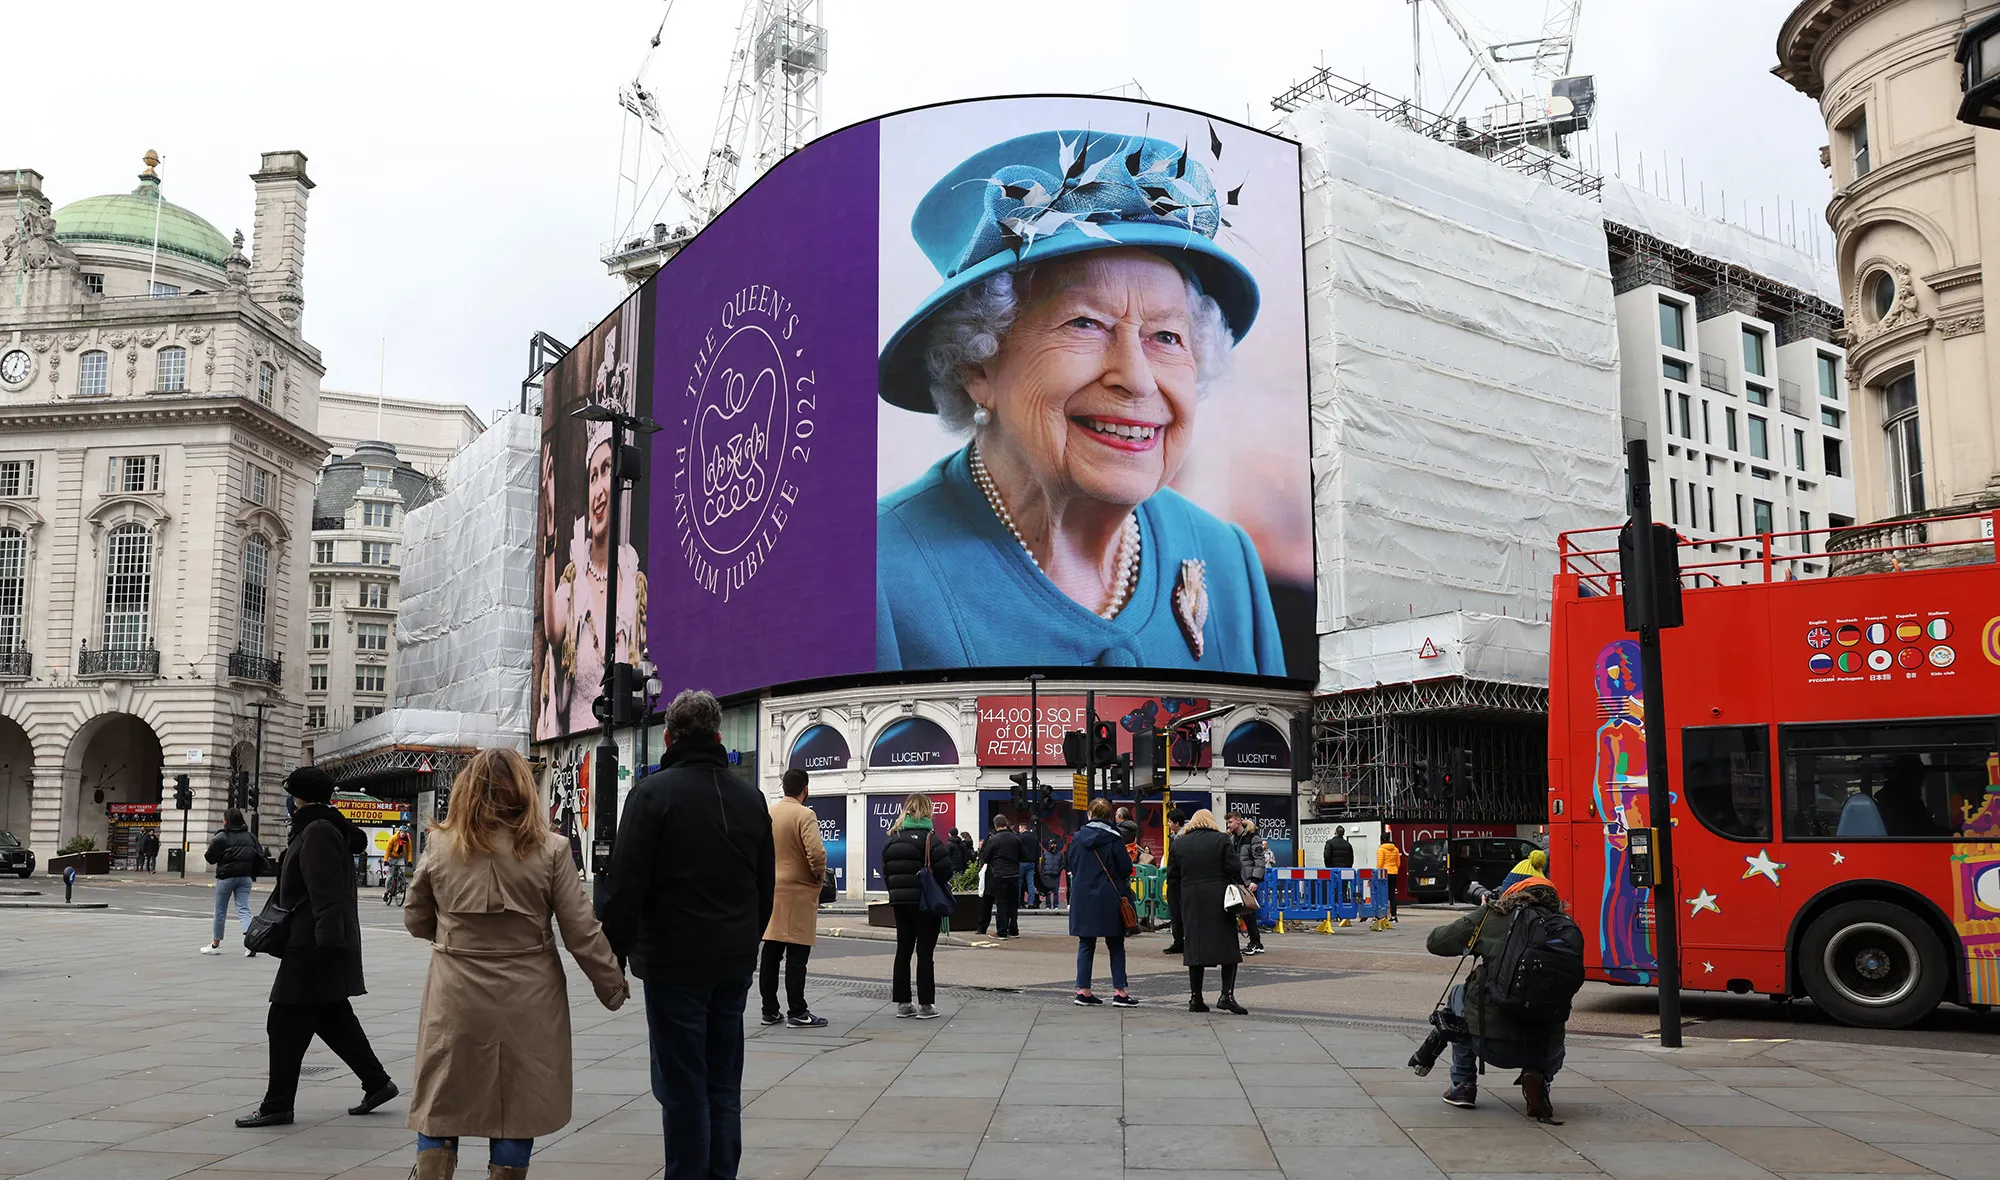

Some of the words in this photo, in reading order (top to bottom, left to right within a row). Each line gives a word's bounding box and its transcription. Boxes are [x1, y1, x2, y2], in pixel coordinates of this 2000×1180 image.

[685, 327, 717, 399] THE
[721, 284, 799, 340] QUEEN'S
[263, 447, 274, 460] LIFE
[277, 455, 294, 470] OFFICE
[674, 445, 719, 595] PLATINUM
[723, 480, 799, 603] JUBILEE
[791, 369, 817, 463] 2022
[978, 707, 1043, 724] 144,000
[1047, 707, 1071, 723] SQ
[1075, 708, 1087, 723] F
[996, 724, 1010, 739] of
[805, 756, 833, 768] LUCENT
[891, 752, 930, 763] LUCENT
[1237, 753, 1269, 763] LUCENT
[1230, 802, 1260, 815] PRIME
[350, 811, 383, 819] HOTDOG
[817, 819, 836, 829] pace
[880, 816, 893, 830] by
[1258, 818, 1286, 829] space
[1304, 827, 1330, 836] COMING
[1305, 835, 1312, 843] Q1
[1313, 835, 1328, 843] 2023
